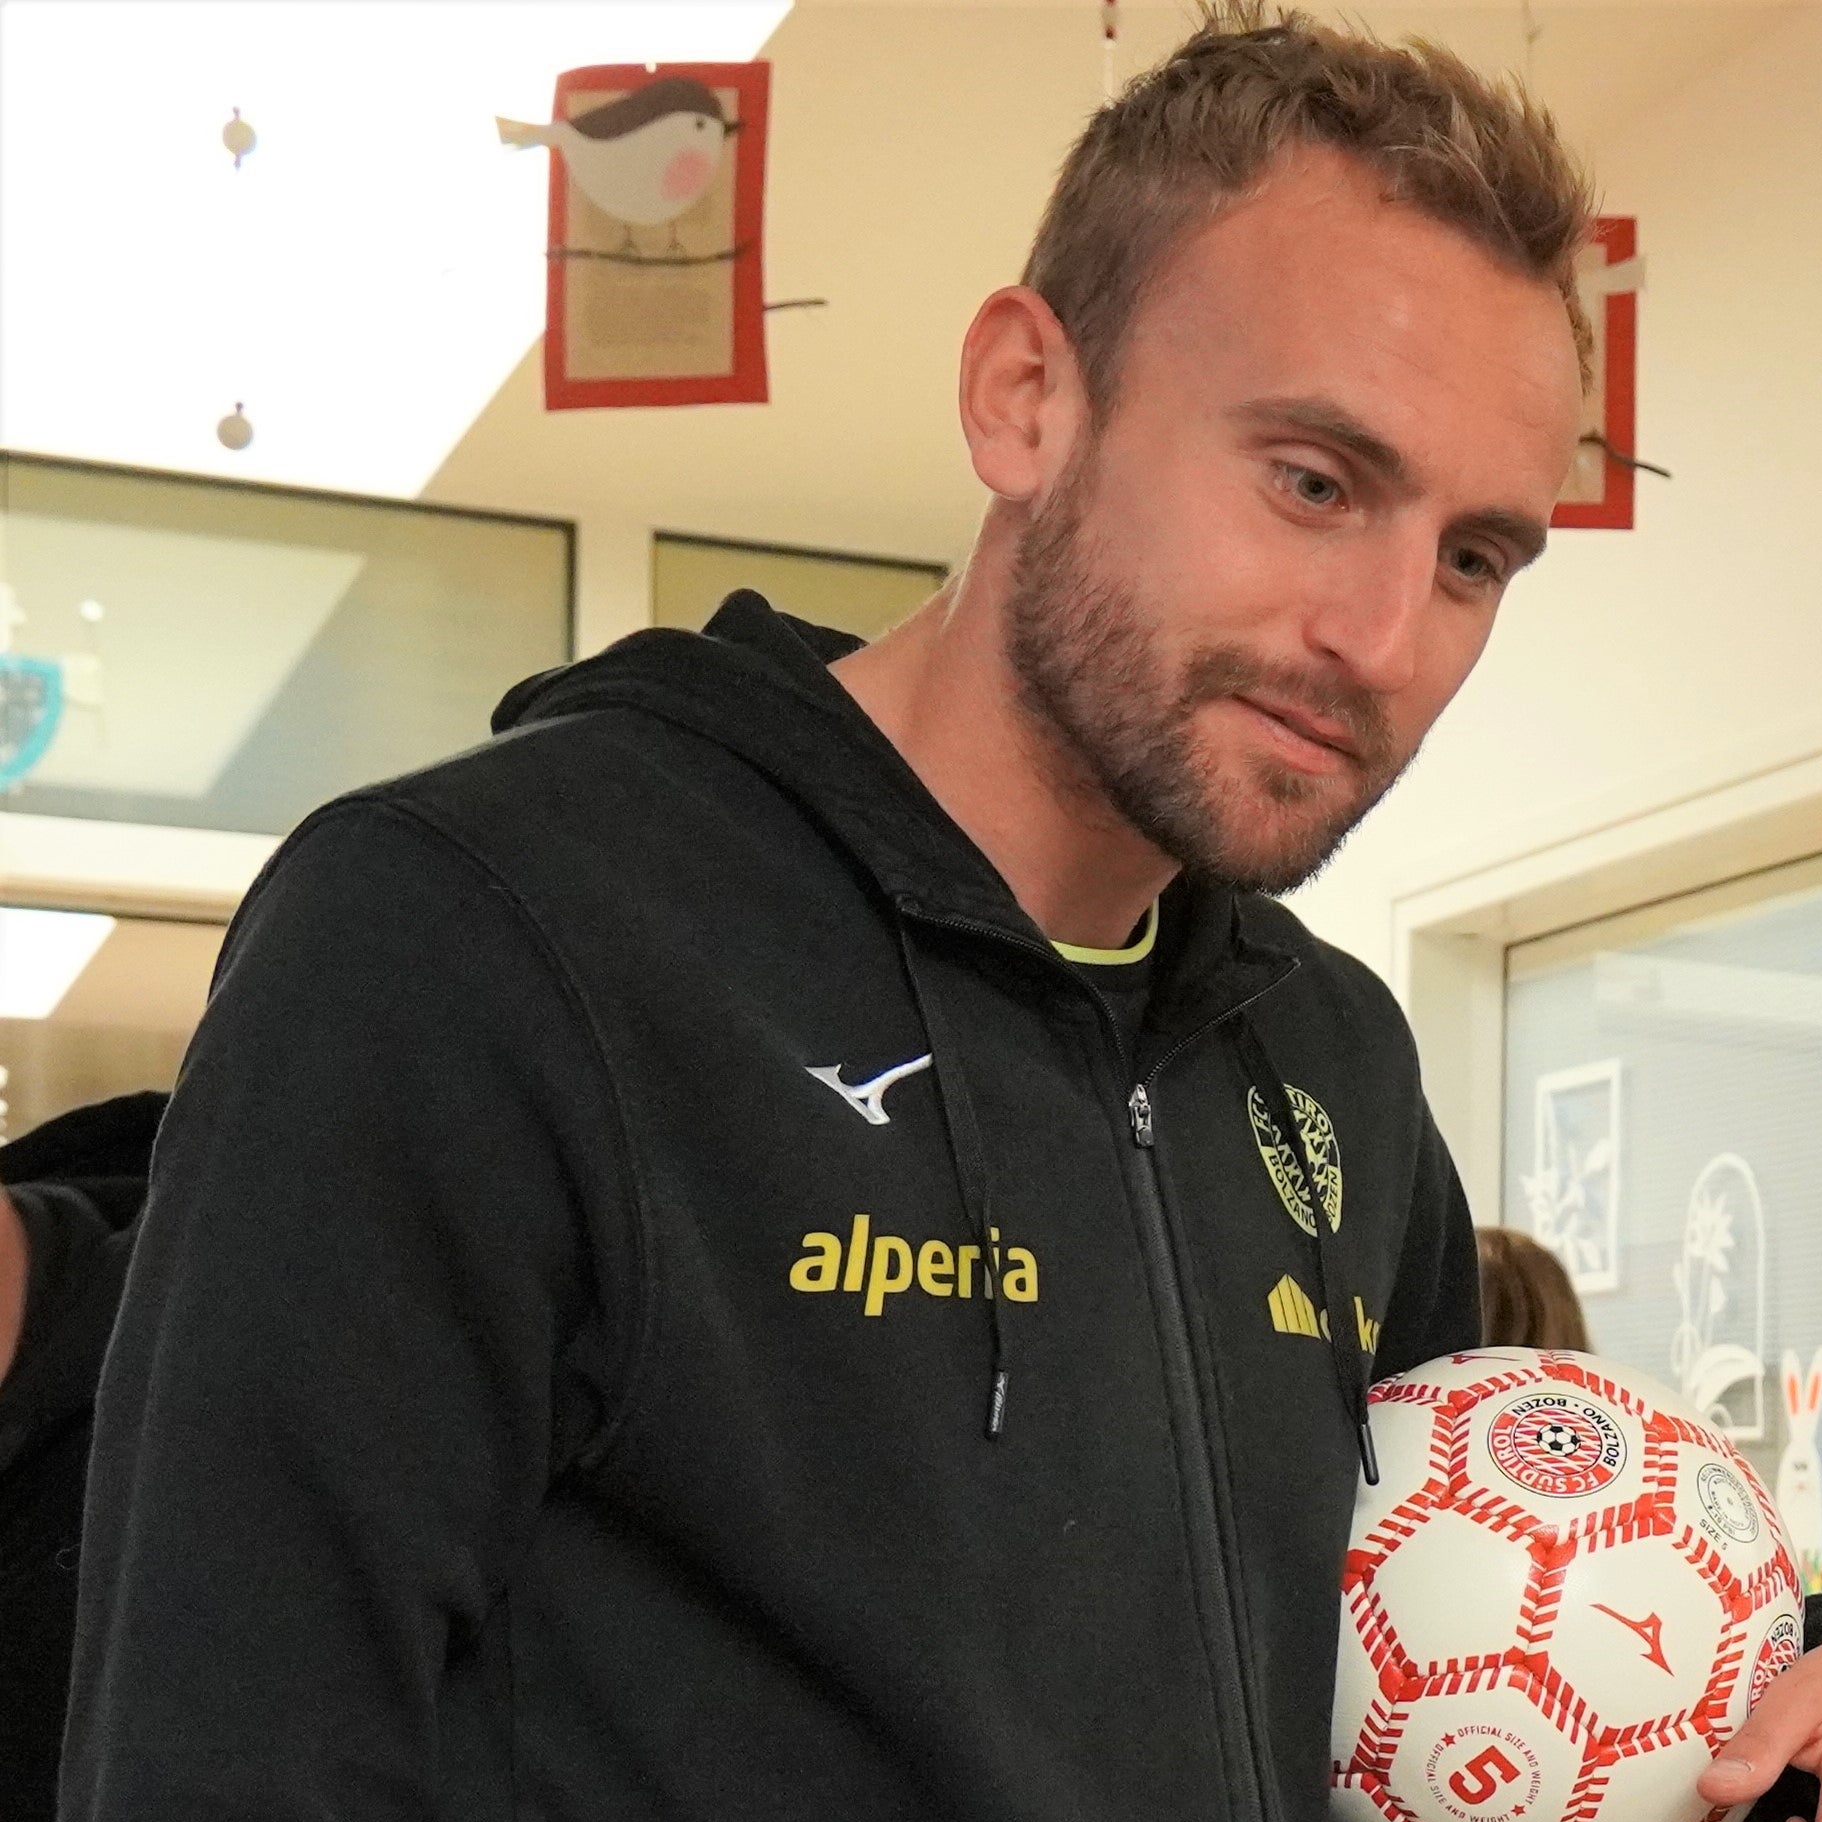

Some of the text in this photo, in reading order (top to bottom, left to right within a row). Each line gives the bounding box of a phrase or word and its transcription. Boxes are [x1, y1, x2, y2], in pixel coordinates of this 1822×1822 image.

[1492, 1424, 1601, 1494] FC SÜDTIROL
[1511, 1396, 1621, 1468] BOLZANO BOZEN
[1699, 1518, 1722, 1544] SIZE
[1426, 1743, 1445, 1783] OFFICIAL
[1445, 1804, 1467, 1819] AND
[1448, 1745, 1521, 1805] 5
[1457, 1725, 1541, 1805] OFFICIAL SIZE AND WEIGHT
